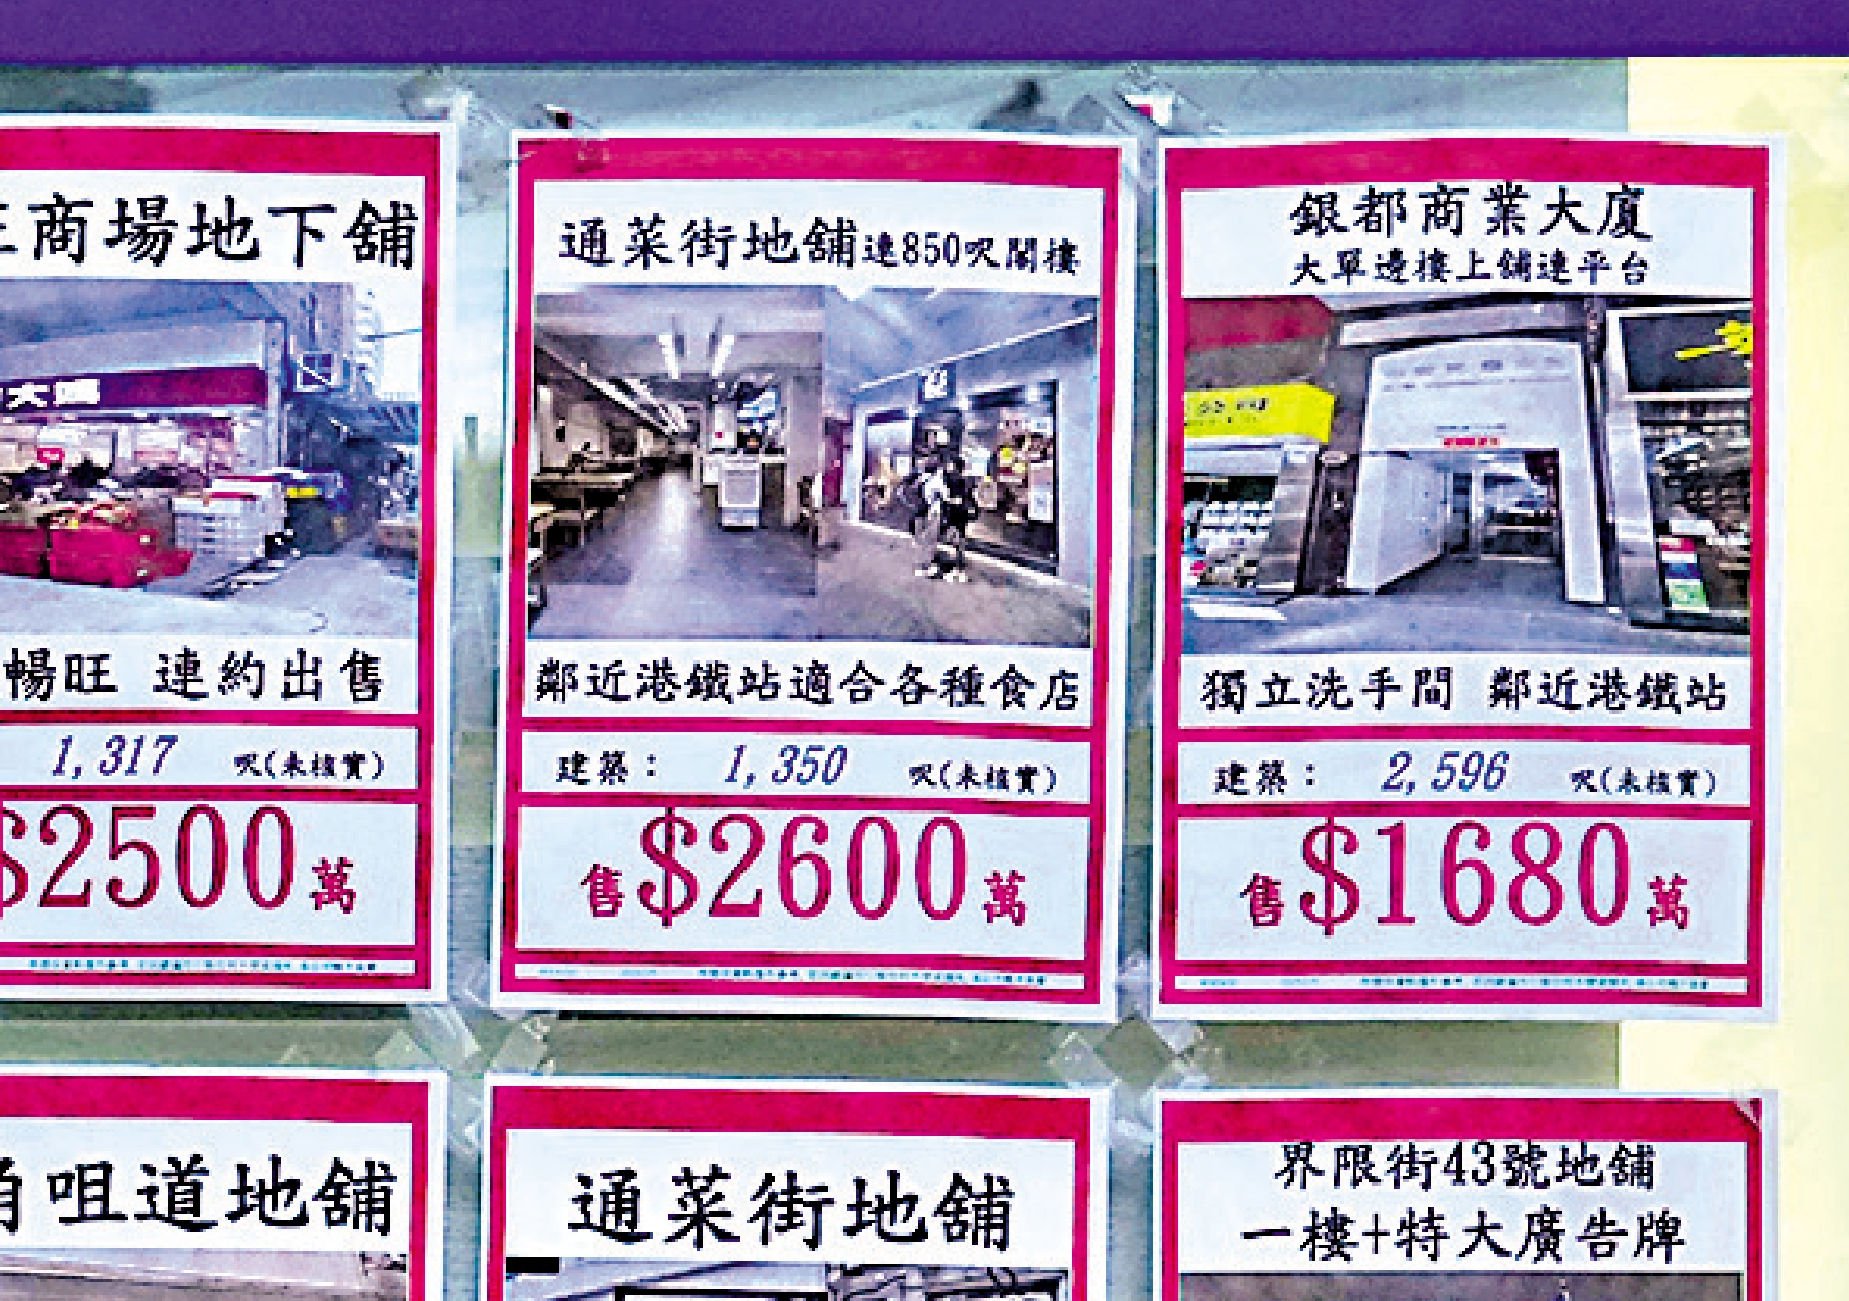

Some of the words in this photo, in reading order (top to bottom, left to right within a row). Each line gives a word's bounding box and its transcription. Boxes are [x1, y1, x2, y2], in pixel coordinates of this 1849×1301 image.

[1289, 182, 1652, 242] 銀都商業大廈
[153, 653, 385, 704] 連約出售
[1201, 669, 1453, 714] 獨立洗手間
[51, 735, 179, 778] 1,317
[722, 746, 849, 787] 1,350
[1381, 751, 1509, 794] 2,596
[1273, 1140, 1657, 1192] 界限街43號地舖
[568, 1165, 1016, 1251] 通菜街地舖
